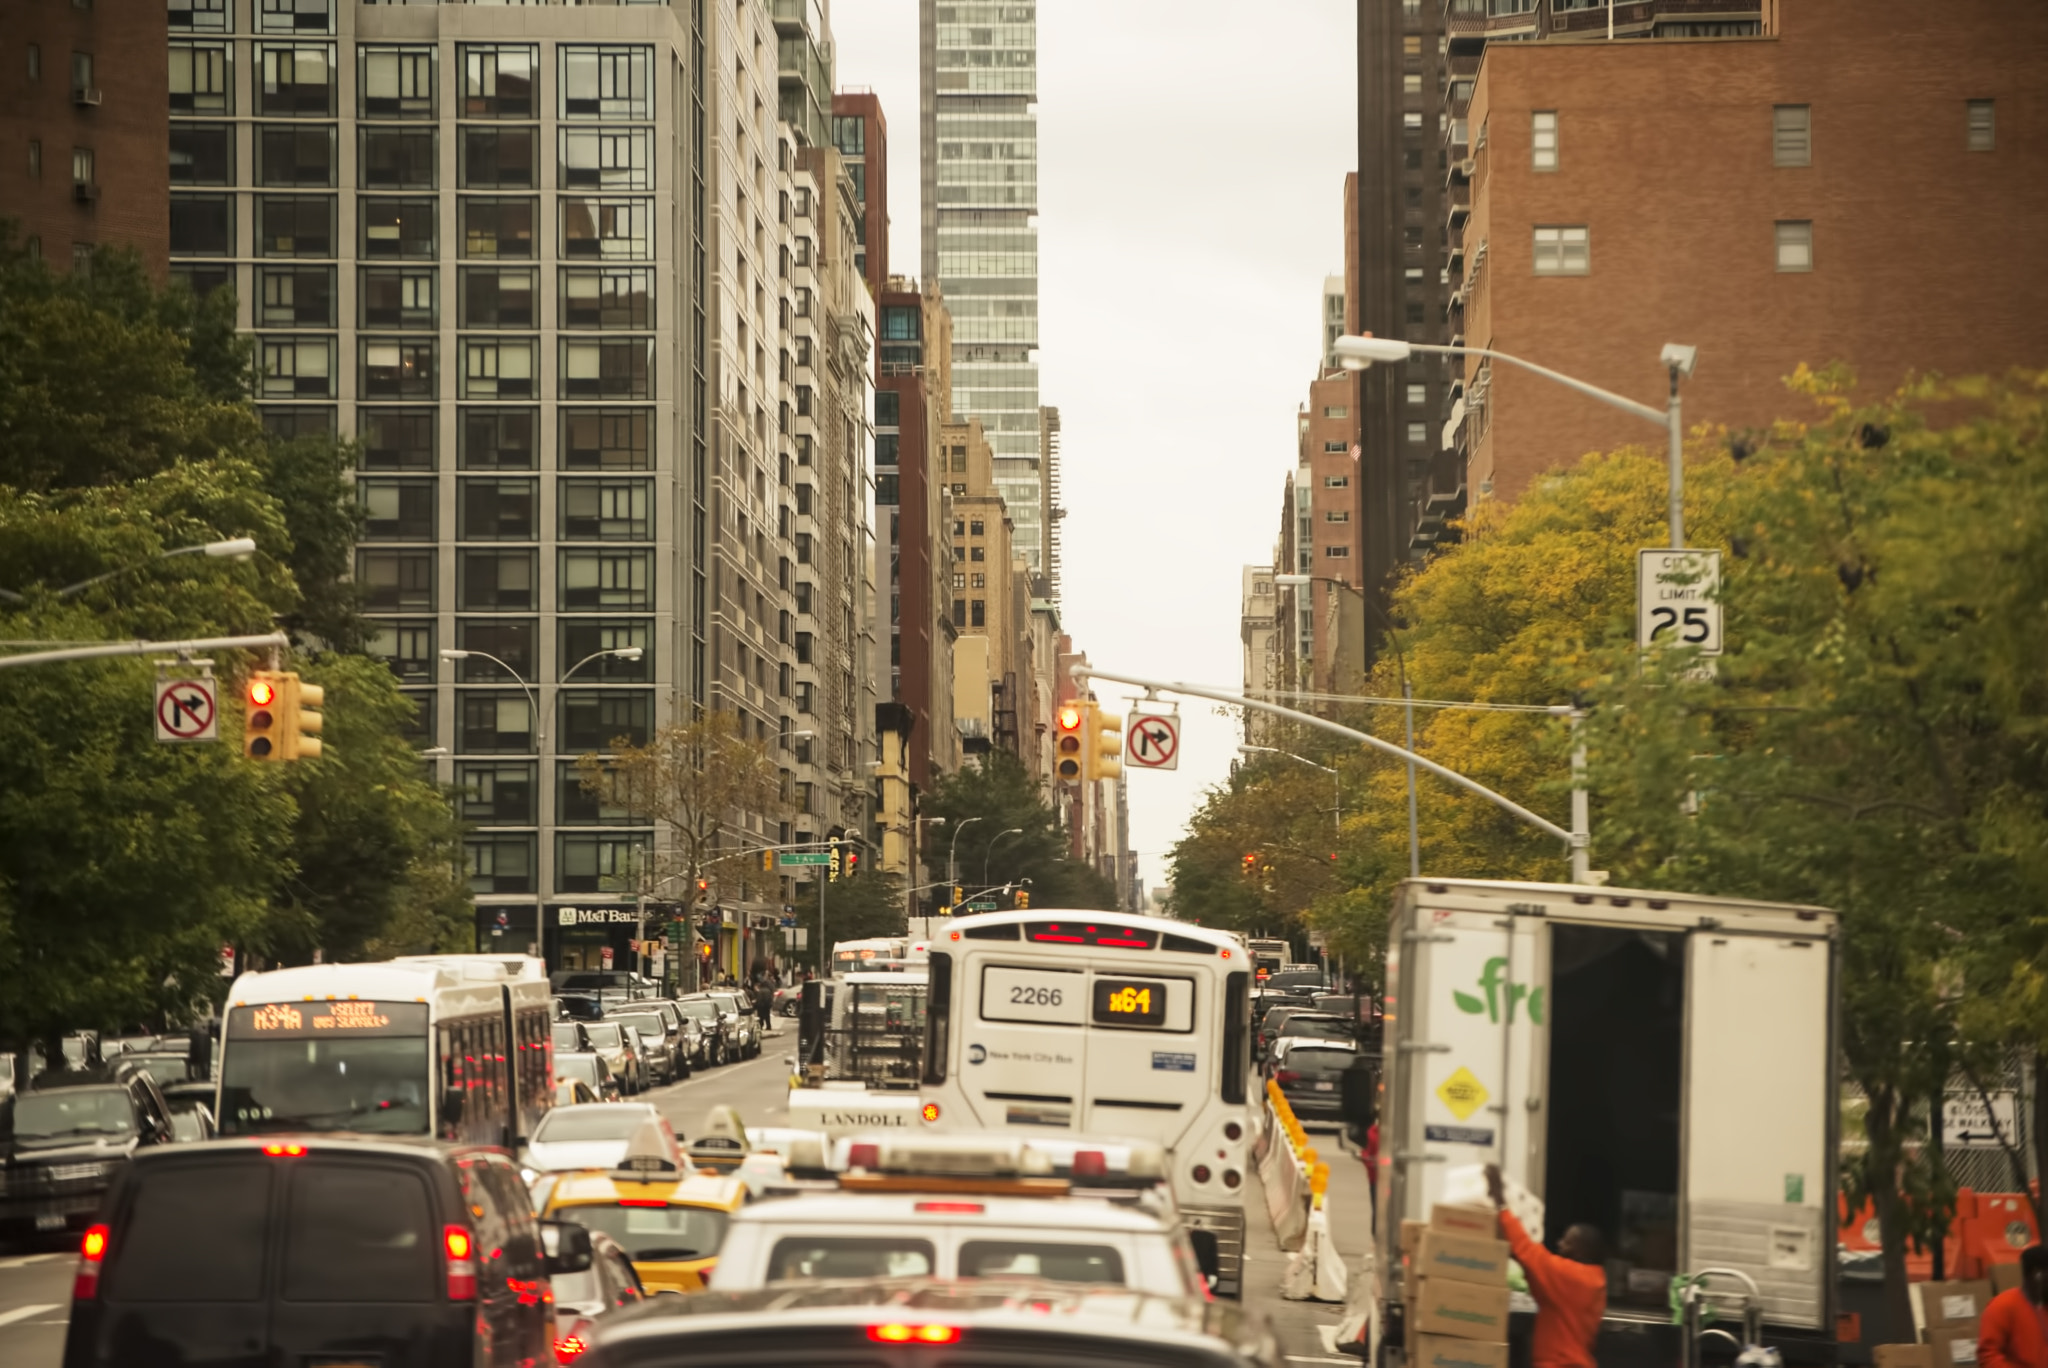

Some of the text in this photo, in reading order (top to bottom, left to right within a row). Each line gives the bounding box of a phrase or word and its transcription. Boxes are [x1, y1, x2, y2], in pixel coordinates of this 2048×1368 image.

[1663, 557, 1698, 569] CIT
[1660, 589, 1697, 600] LIMIT
[1650, 606, 1710, 643] 25
[578, 909, 608, 923] M&T
[1010, 986, 1063, 1006] 2266
[821, 1113, 908, 1127] LANDOLL
